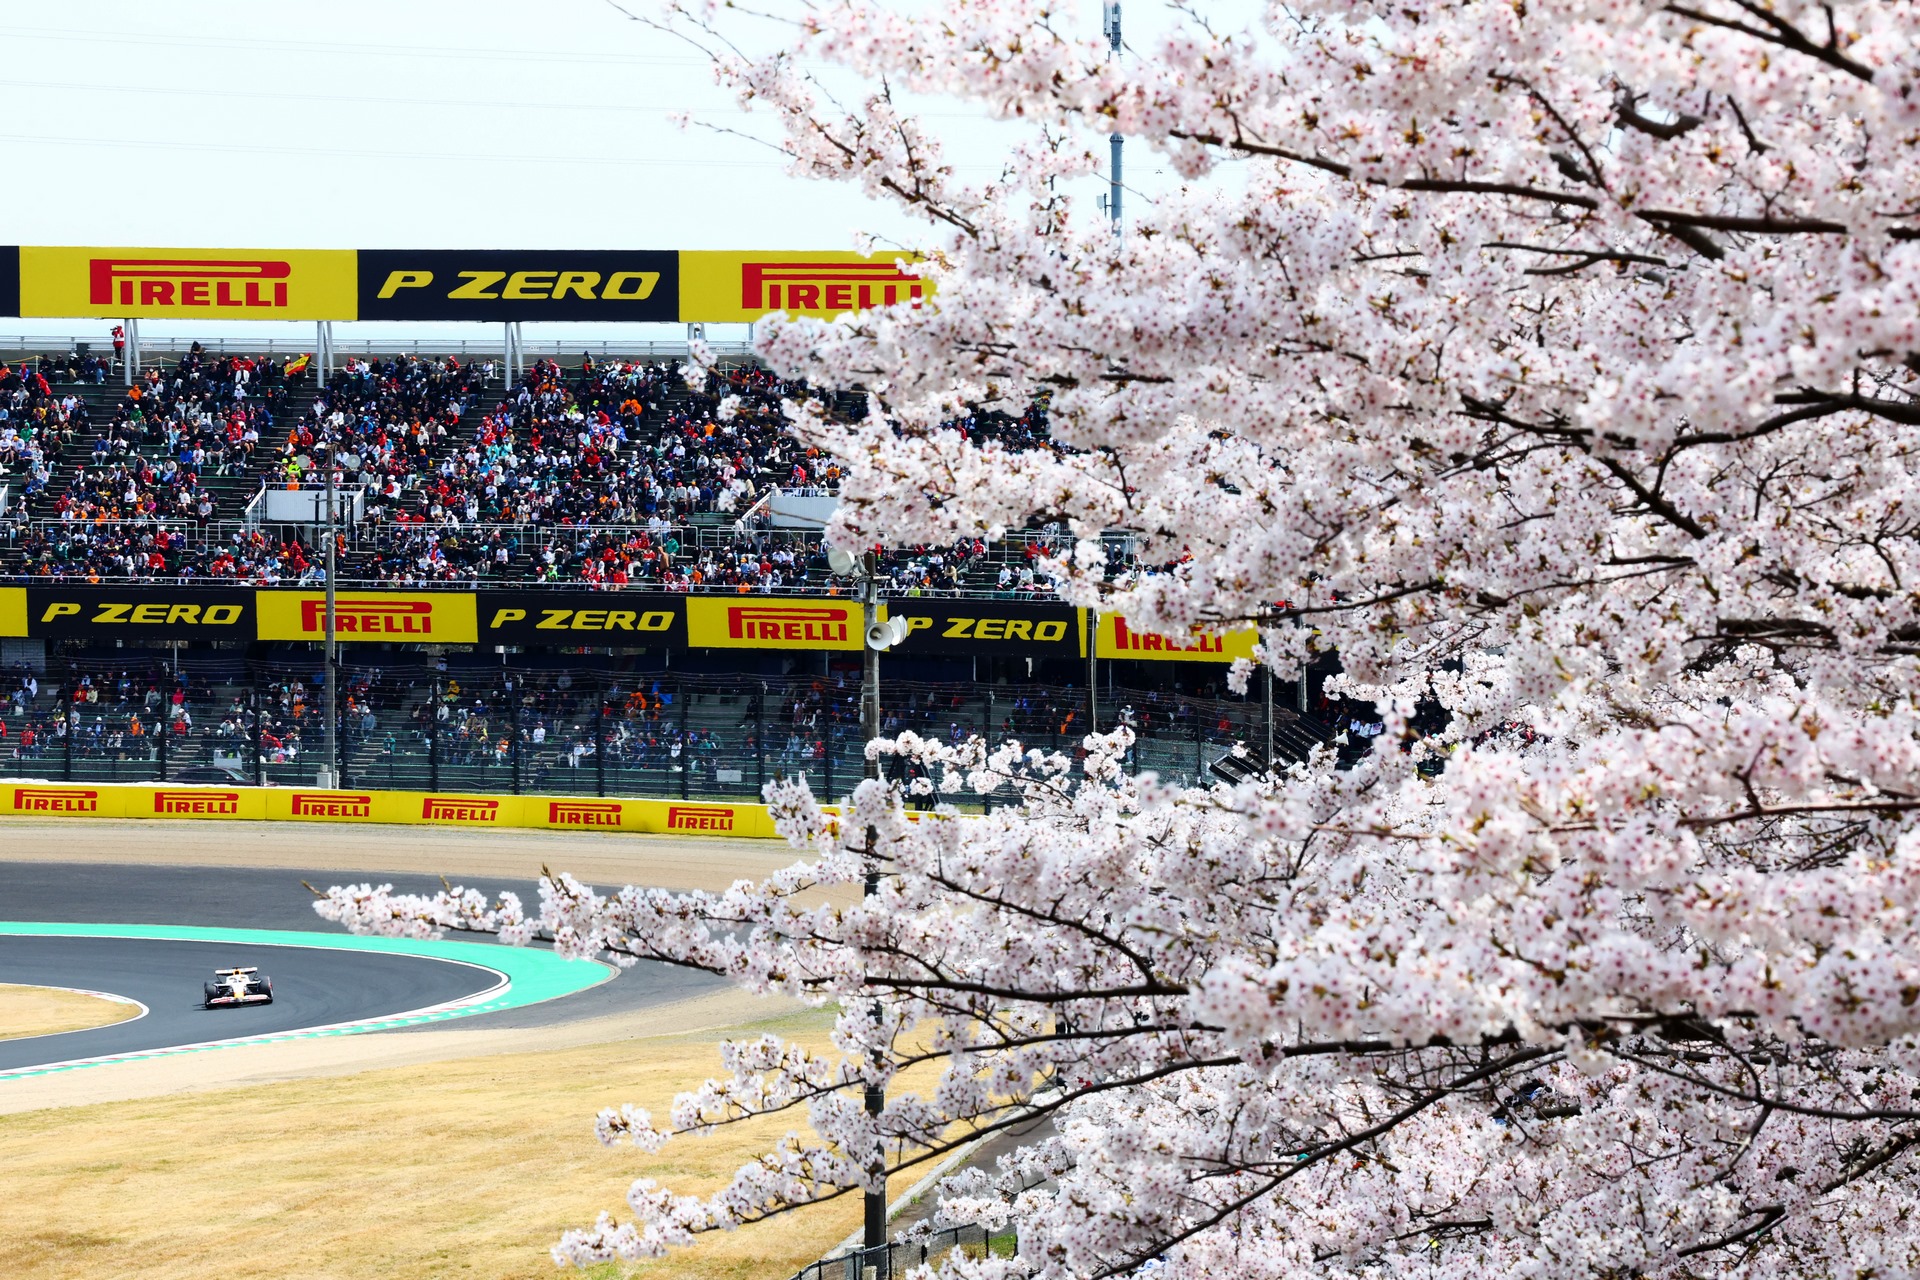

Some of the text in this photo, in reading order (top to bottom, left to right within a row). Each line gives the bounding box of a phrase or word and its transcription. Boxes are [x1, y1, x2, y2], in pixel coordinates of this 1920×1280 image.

[89, 258, 291, 306] PIRELLI
[377, 270, 661, 300] P ZERO
[741, 262, 923, 310] PIRELLI
[41, 602, 243, 625] P ZERO
[301, 600, 433, 634] PIRELLI
[490, 608, 675, 632] P ZERO
[727, 606, 848, 642] PIRELLI
[906, 617, 1068, 642] P ZERO
[1113, 616, 1223, 653] IRLI
[14, 788, 98, 812] PIRELLI
[154, 792, 239, 814] PIRELLI
[291, 794, 371, 817] PIRELLI
[422, 798, 499, 821] PIRELLI
[548, 802, 622, 826] PIRELLI
[667, 806, 734, 831] PIRELLI
